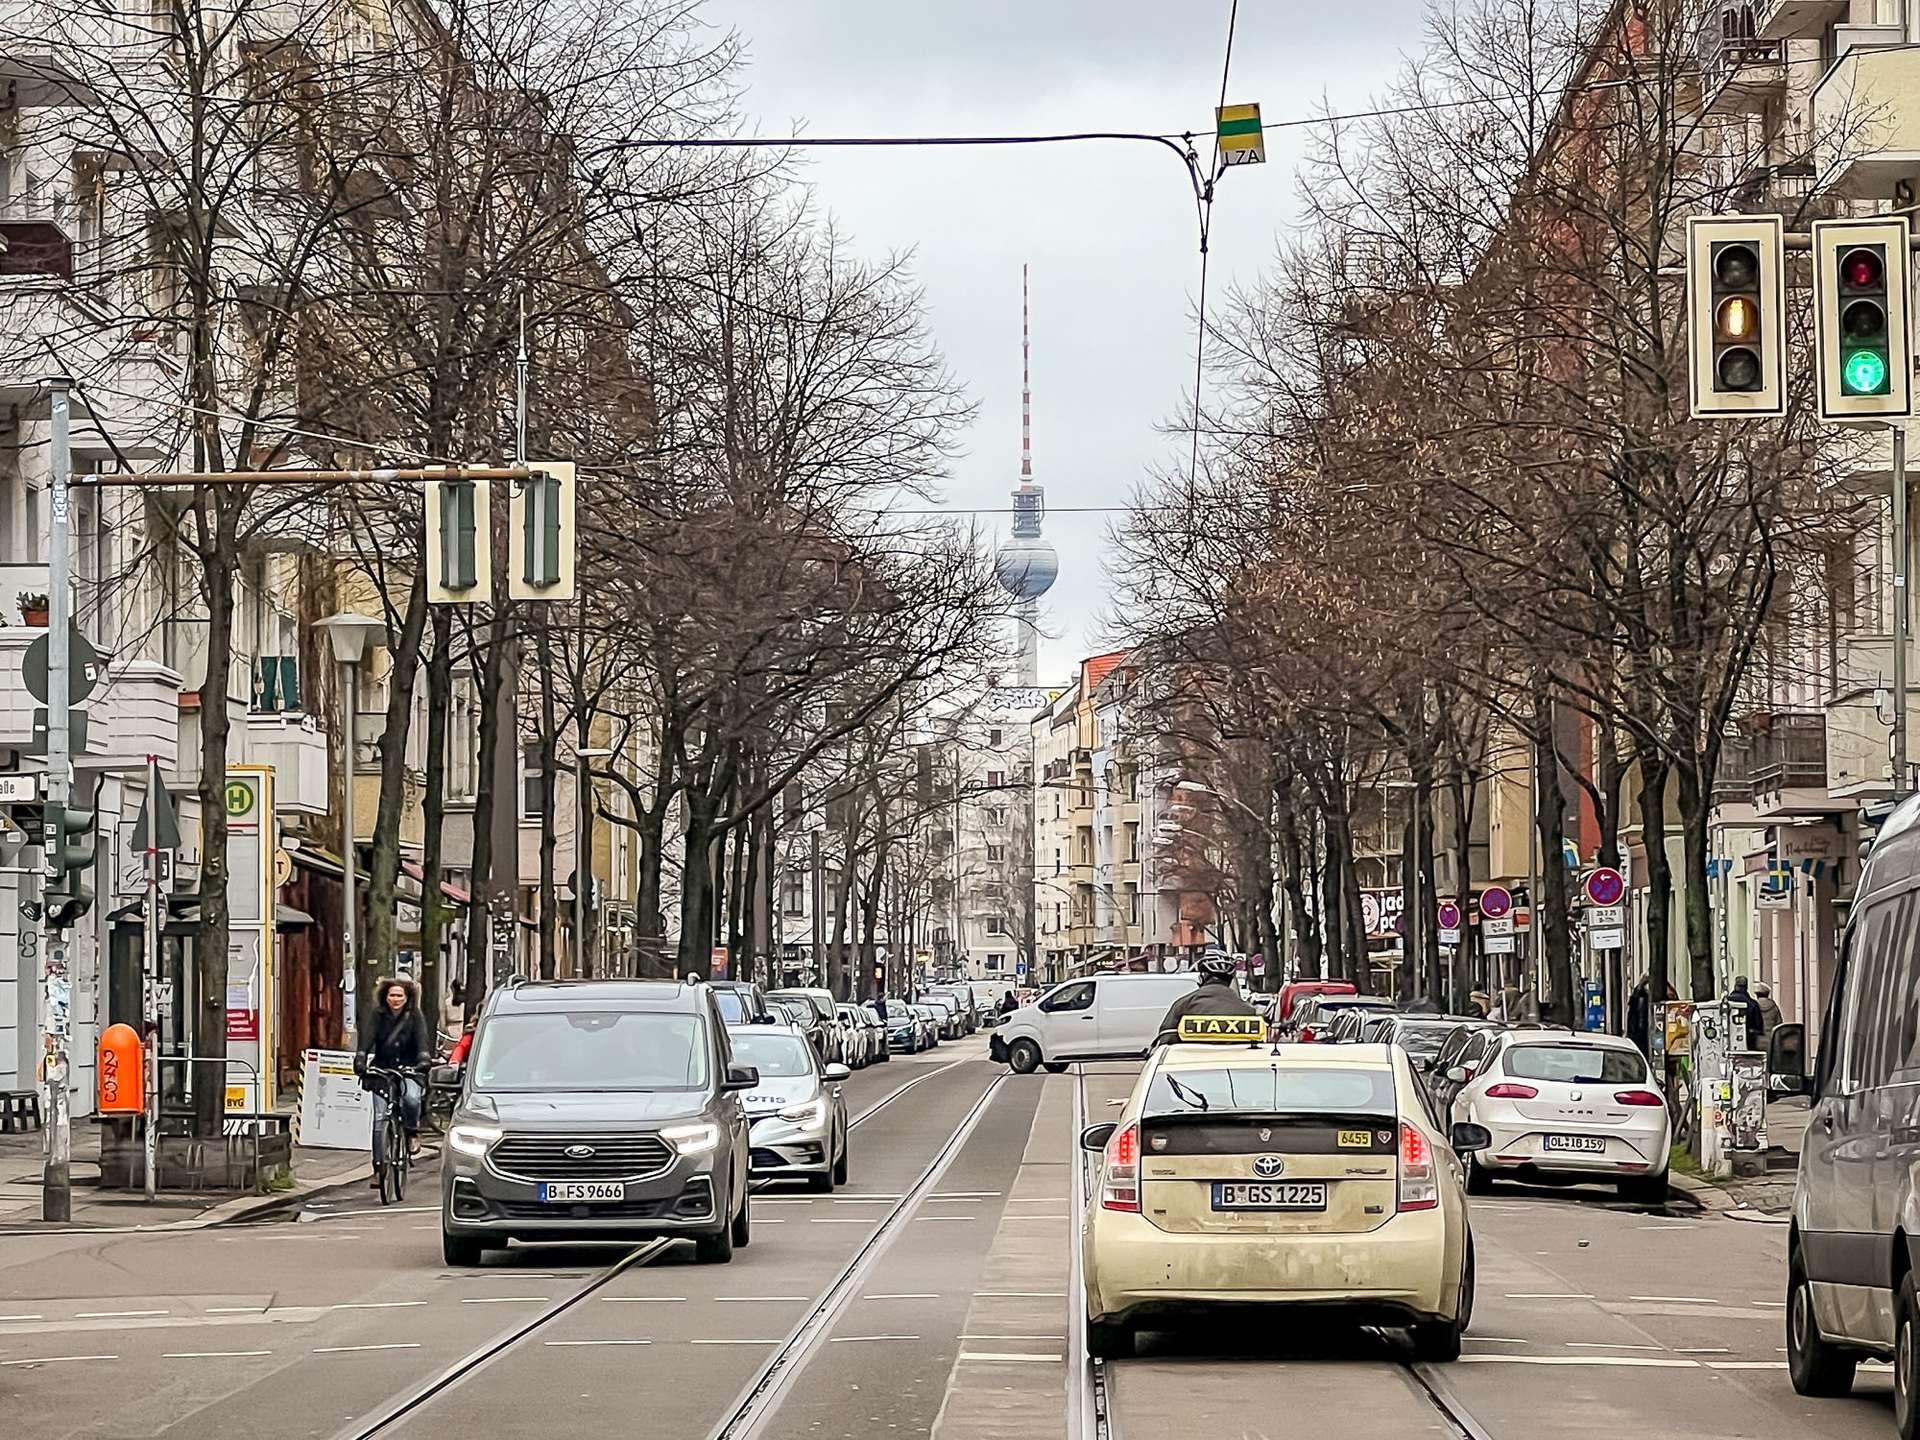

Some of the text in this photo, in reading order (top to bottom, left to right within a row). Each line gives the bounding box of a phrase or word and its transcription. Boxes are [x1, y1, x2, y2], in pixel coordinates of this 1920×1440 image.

[228, 789, 245, 809] H
[1193, 1020, 1251, 1034] TAXI
[227, 1098, 244, 1107] BVG
[746, 1095, 786, 1104] OTIS
[1341, 1132, 1369, 1144] 6455
[1584, 1139, 1603, 1150] 159
[548, 1185, 622, 1199] B FS 9666
[1223, 1186, 1322, 1204] B GS 1225
